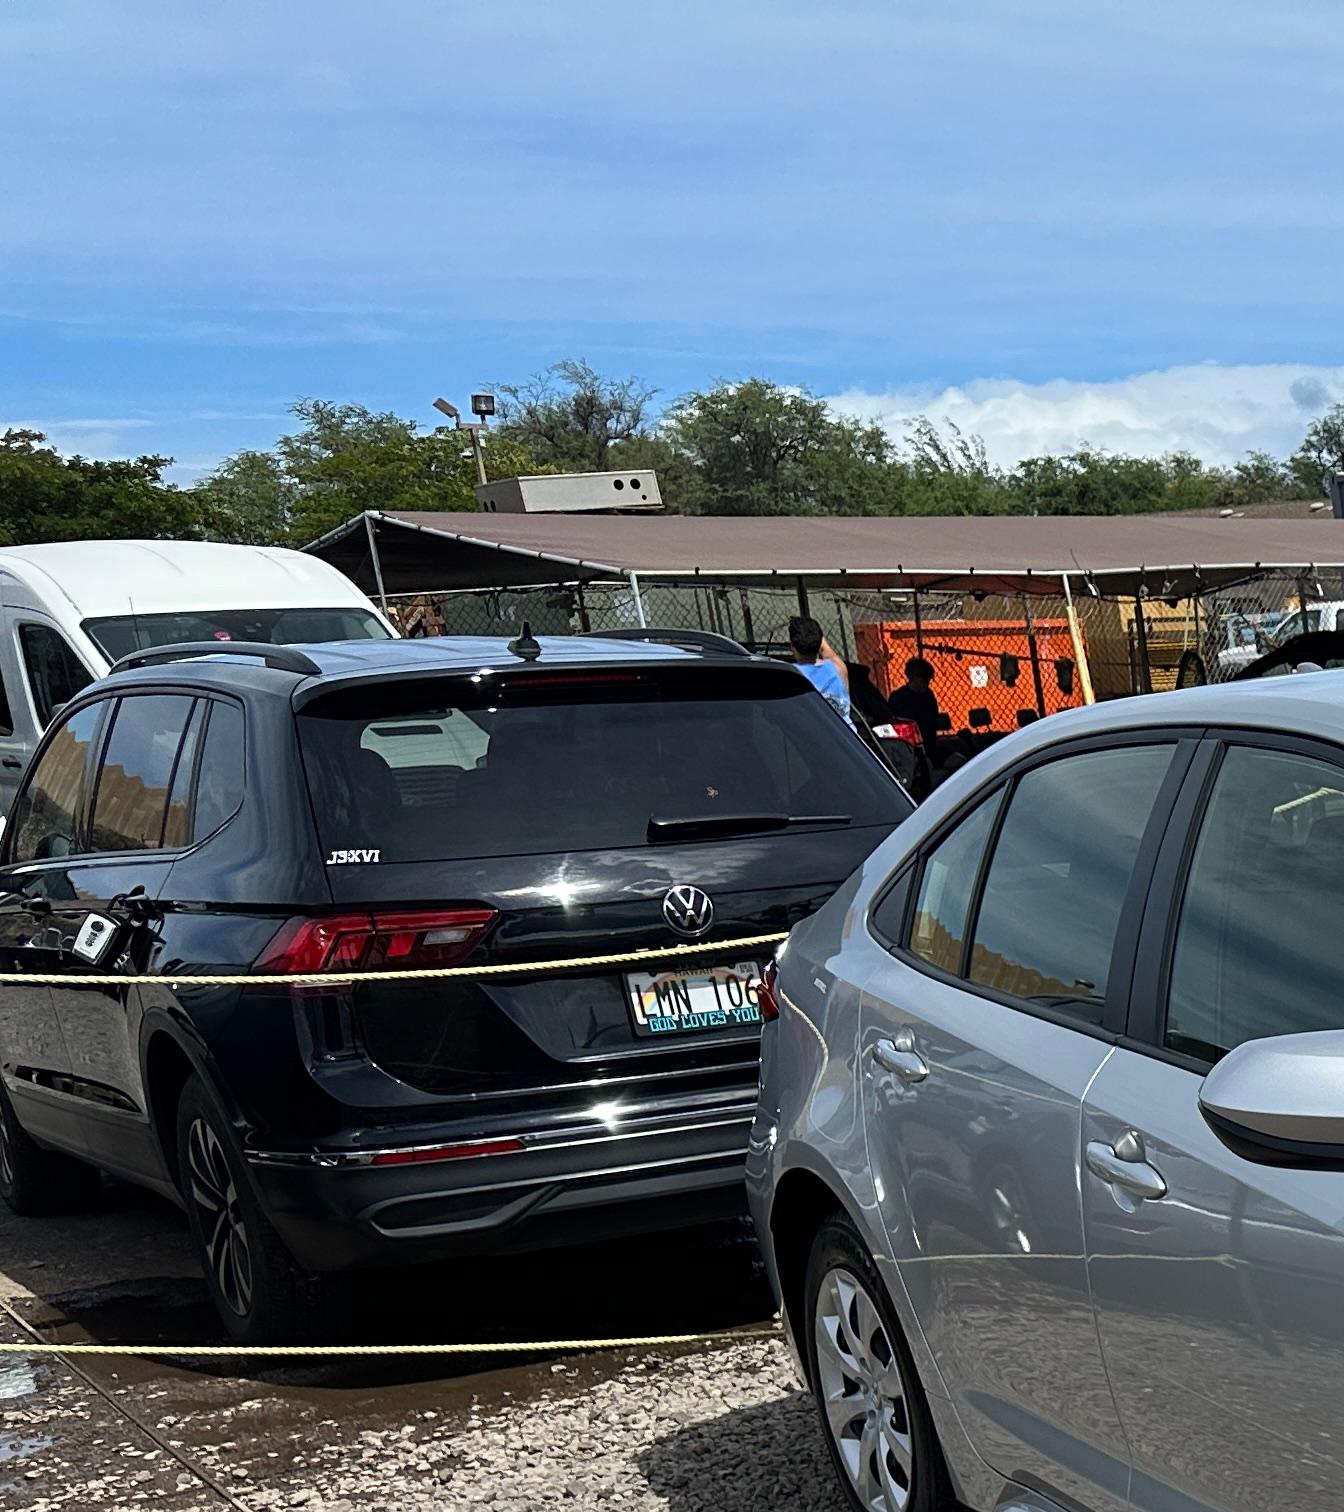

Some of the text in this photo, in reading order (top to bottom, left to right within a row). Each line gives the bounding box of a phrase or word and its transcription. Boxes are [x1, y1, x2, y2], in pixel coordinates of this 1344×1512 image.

[635, 974, 759, 1018] LMN 106
[648, 1007, 760, 1033] GOD LOVES YOU
